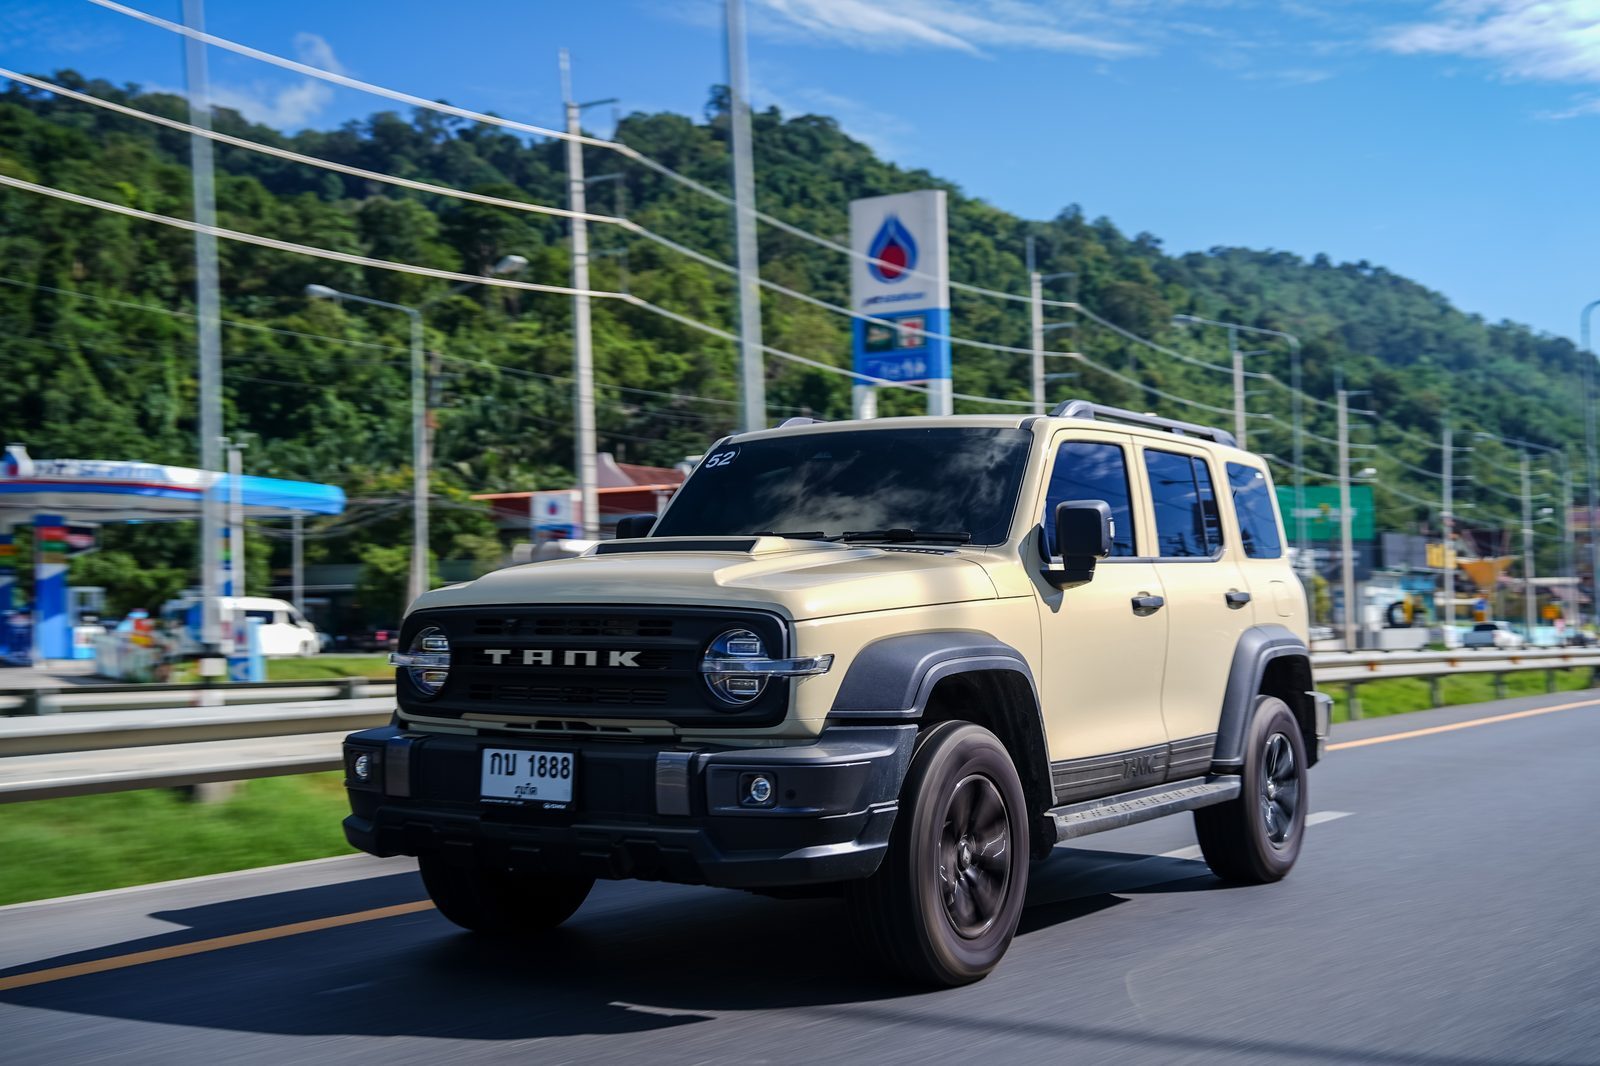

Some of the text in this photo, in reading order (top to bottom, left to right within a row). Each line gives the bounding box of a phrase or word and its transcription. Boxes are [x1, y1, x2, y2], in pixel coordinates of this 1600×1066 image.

[705, 450, 736, 469] 52
[483, 649, 642, 667] TANK
[528, 754, 570, 779] 1888
